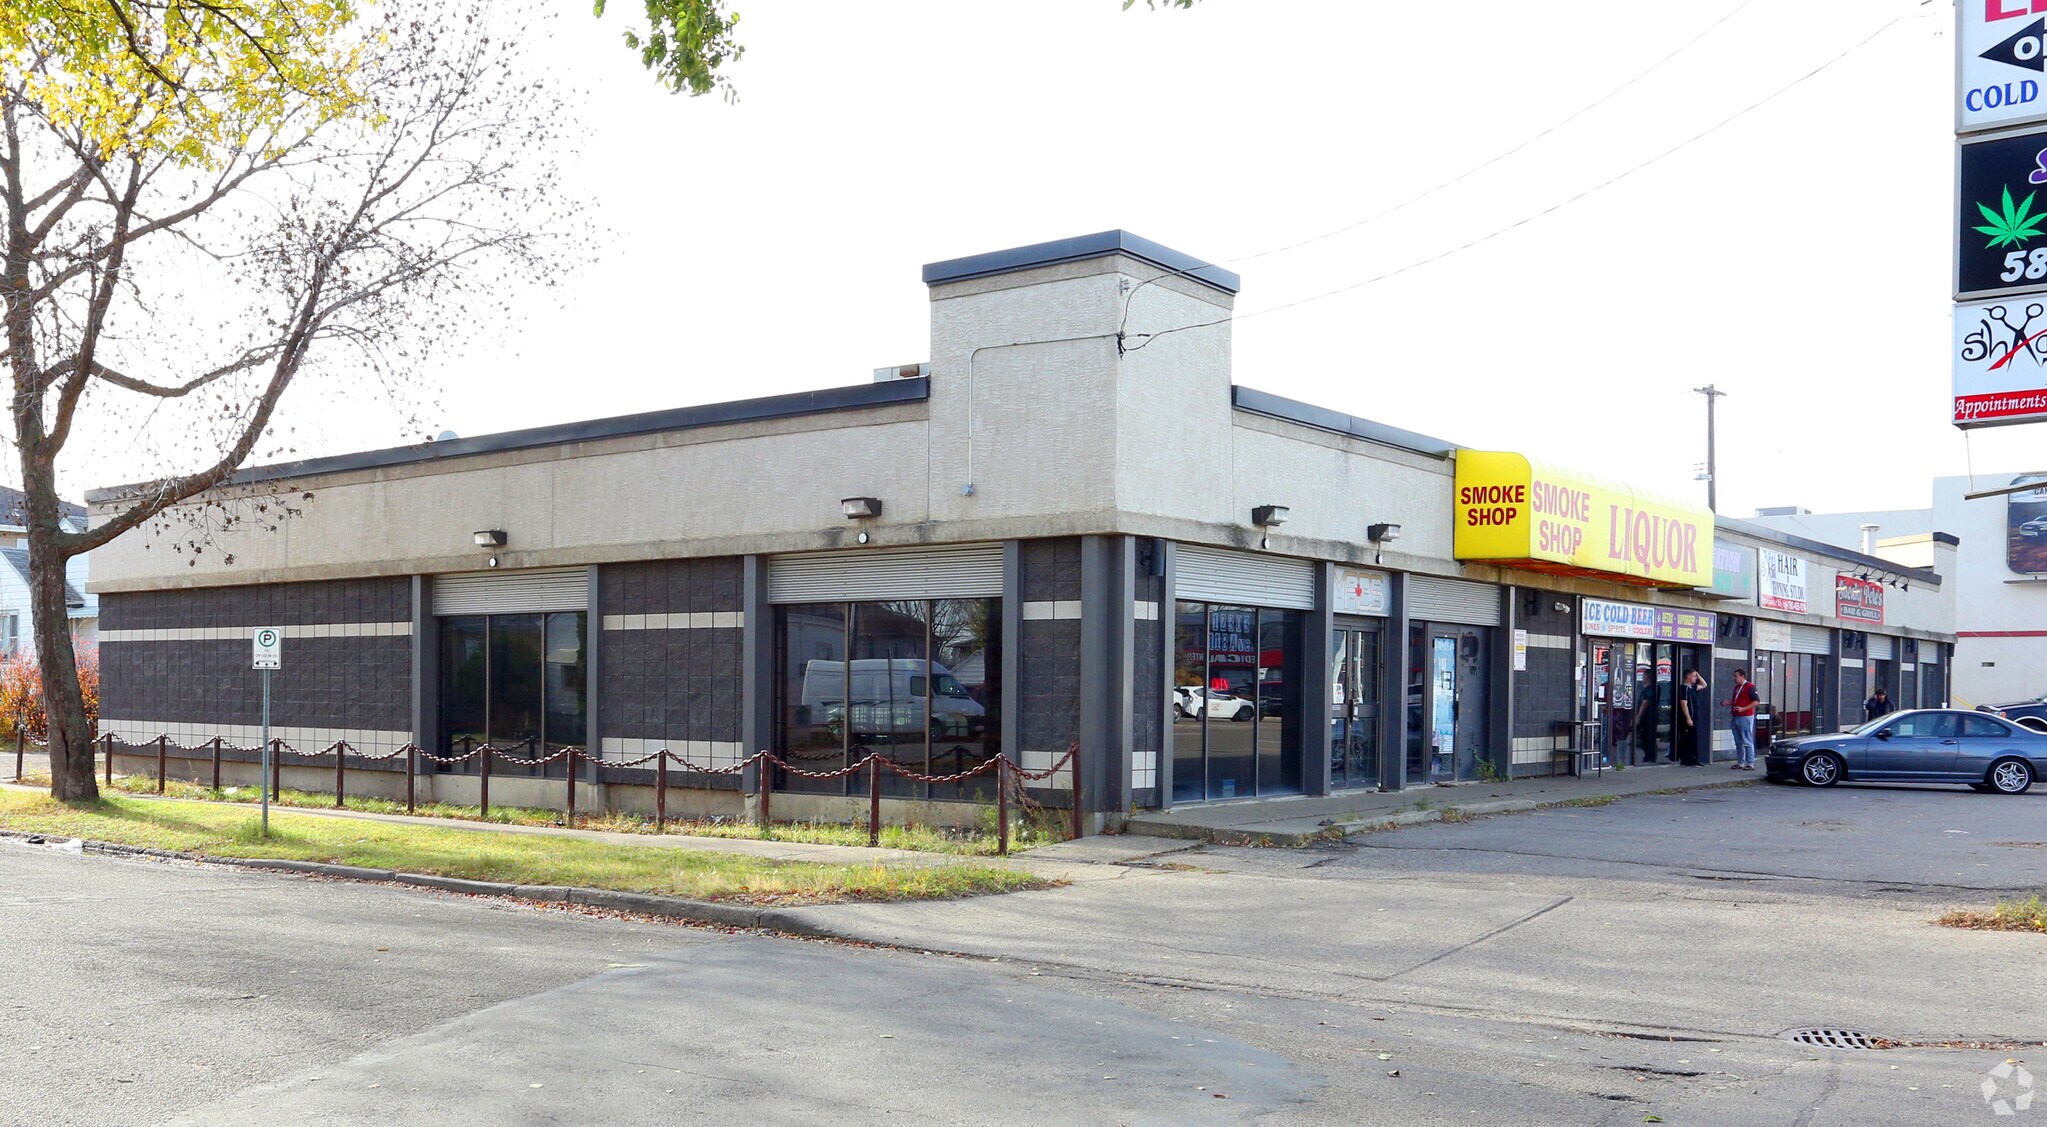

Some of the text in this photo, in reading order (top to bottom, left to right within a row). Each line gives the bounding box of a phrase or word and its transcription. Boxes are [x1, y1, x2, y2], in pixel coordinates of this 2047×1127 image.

[2014, 33, 2047, 60] O
[1966, 79, 2038, 112] COLD
[1955, 394, 2047, 419] Appointments
[1460, 485, 1525, 505] SMOKE
[1532, 480, 1590, 523] SMOKE
[1467, 507, 1517, 526] SHOP
[1539, 520, 1582, 555] SHOP
[1609, 504, 1697, 574] LIQUOR
[1778, 554, 1798, 576] HAIR
[1584, 602, 1601, 621] ICE
[1603, 604, 1629, 624] COLD
[1631, 607, 1654, 626] BEER
[1843, 606, 1879, 619] BAR & GRILL
[263, 634, 272, 643] P
[1633, 627, 1653, 635] COOLERS
